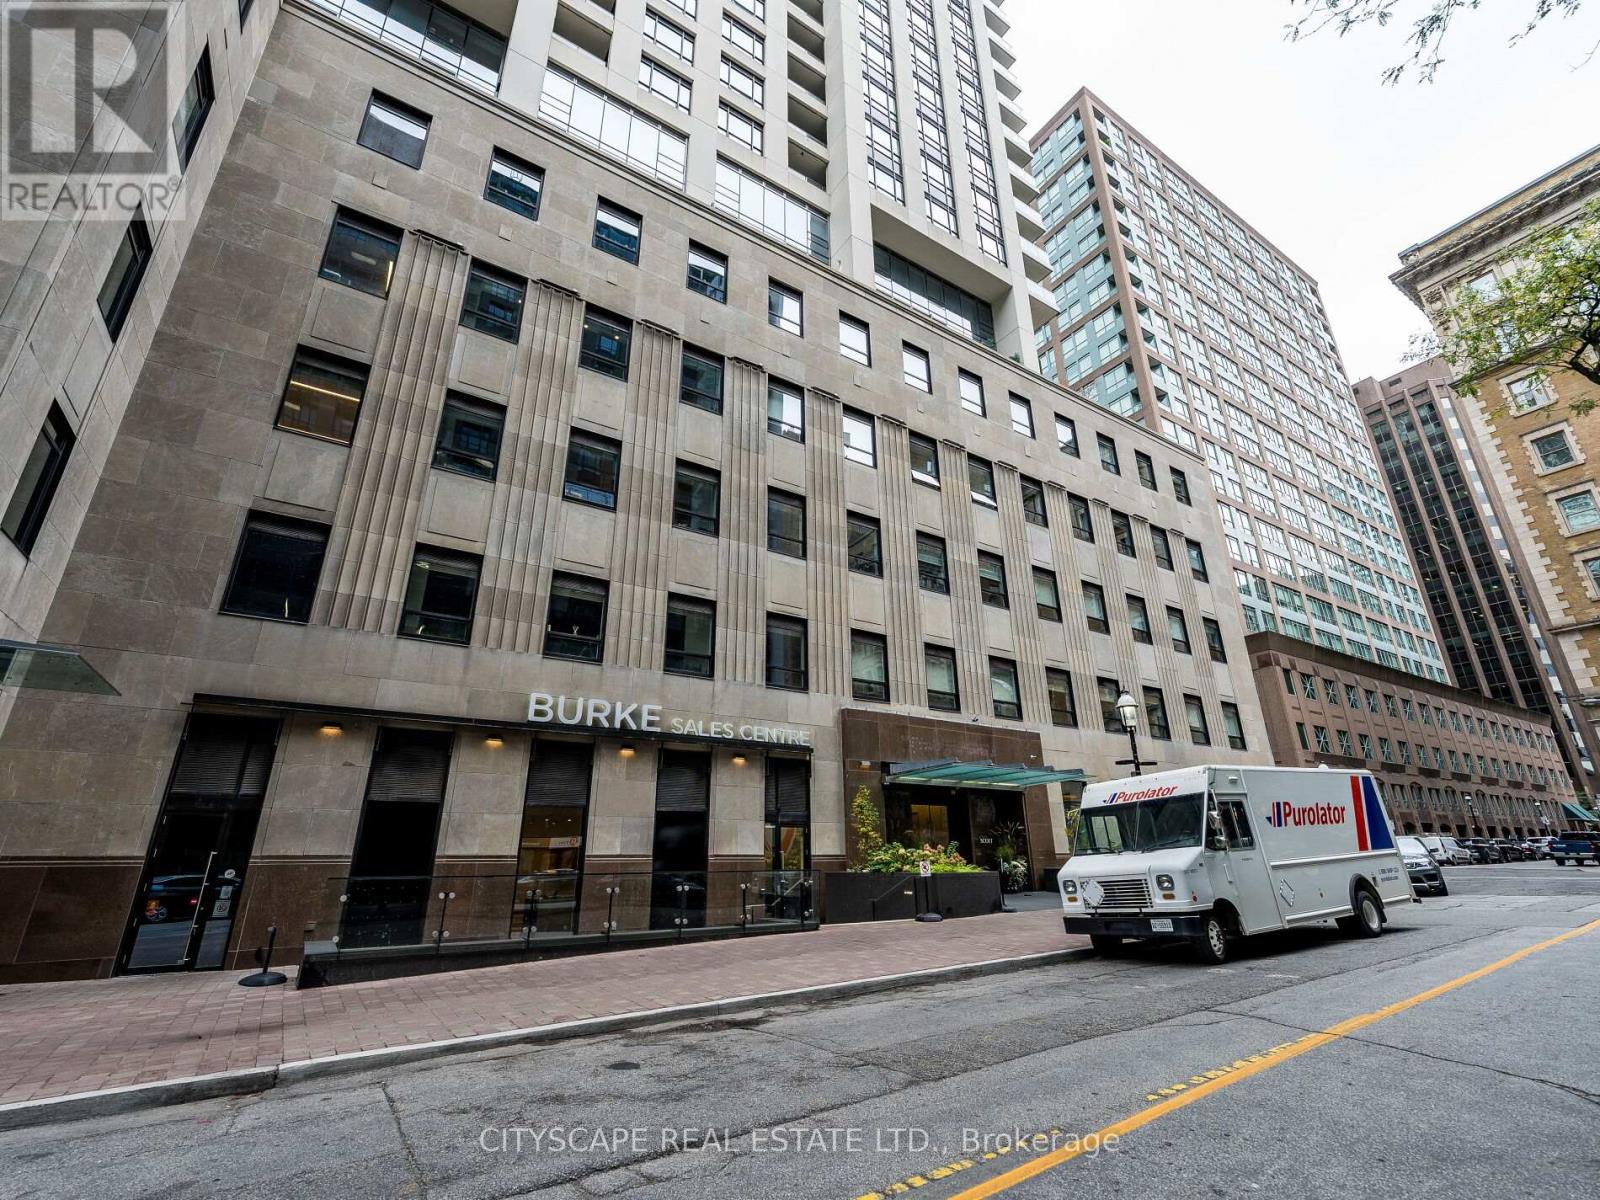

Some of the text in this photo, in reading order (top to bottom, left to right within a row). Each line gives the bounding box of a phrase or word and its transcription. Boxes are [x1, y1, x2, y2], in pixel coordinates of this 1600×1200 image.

[527, 692, 811, 746] BURKE SALES CENTRE
[1115, 785, 1179, 803] Purolator
[1282, 801, 1346, 828] Purolator
